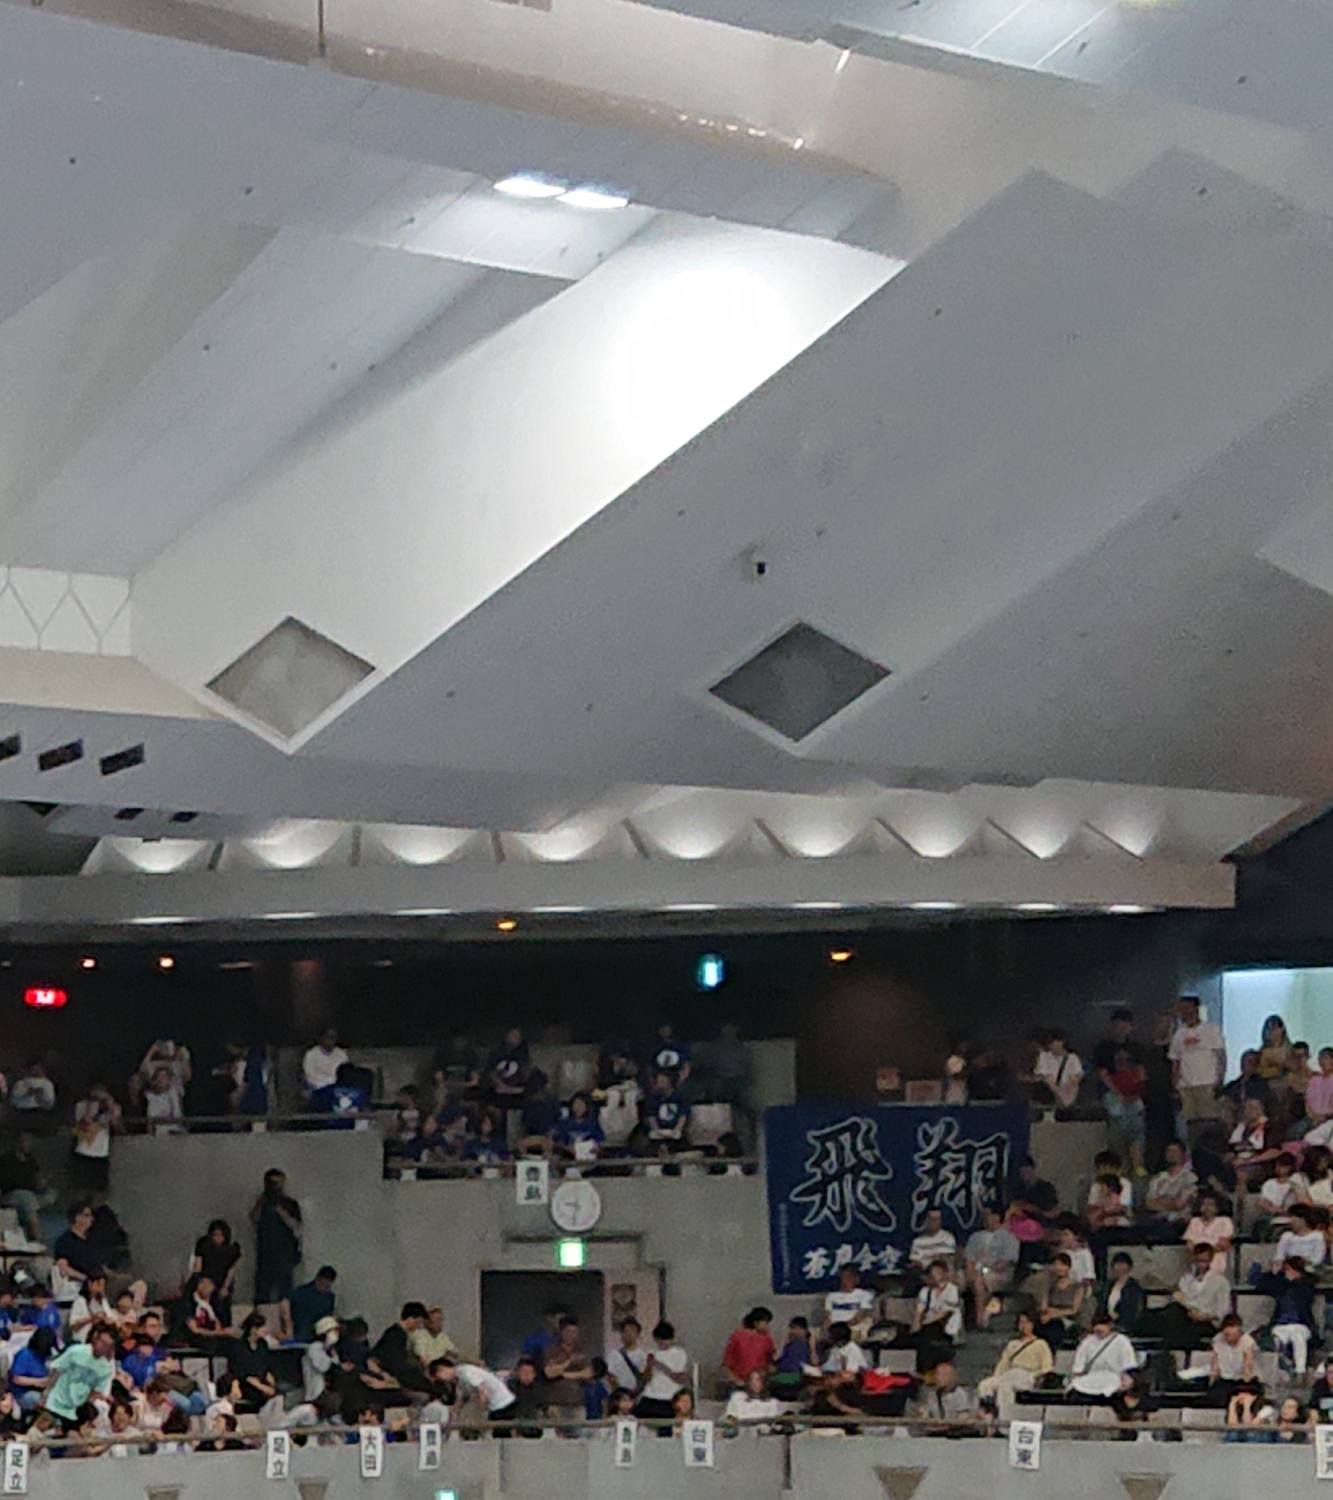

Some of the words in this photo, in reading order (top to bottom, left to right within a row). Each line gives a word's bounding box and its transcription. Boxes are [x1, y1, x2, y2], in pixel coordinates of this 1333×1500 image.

[790, 1115, 1010, 1232] 飛翔
[271, 1437, 286, 1476] 足立
[1017, 1426, 1034, 1466] 台東
[9, 1449, 23, 1489] 足立
